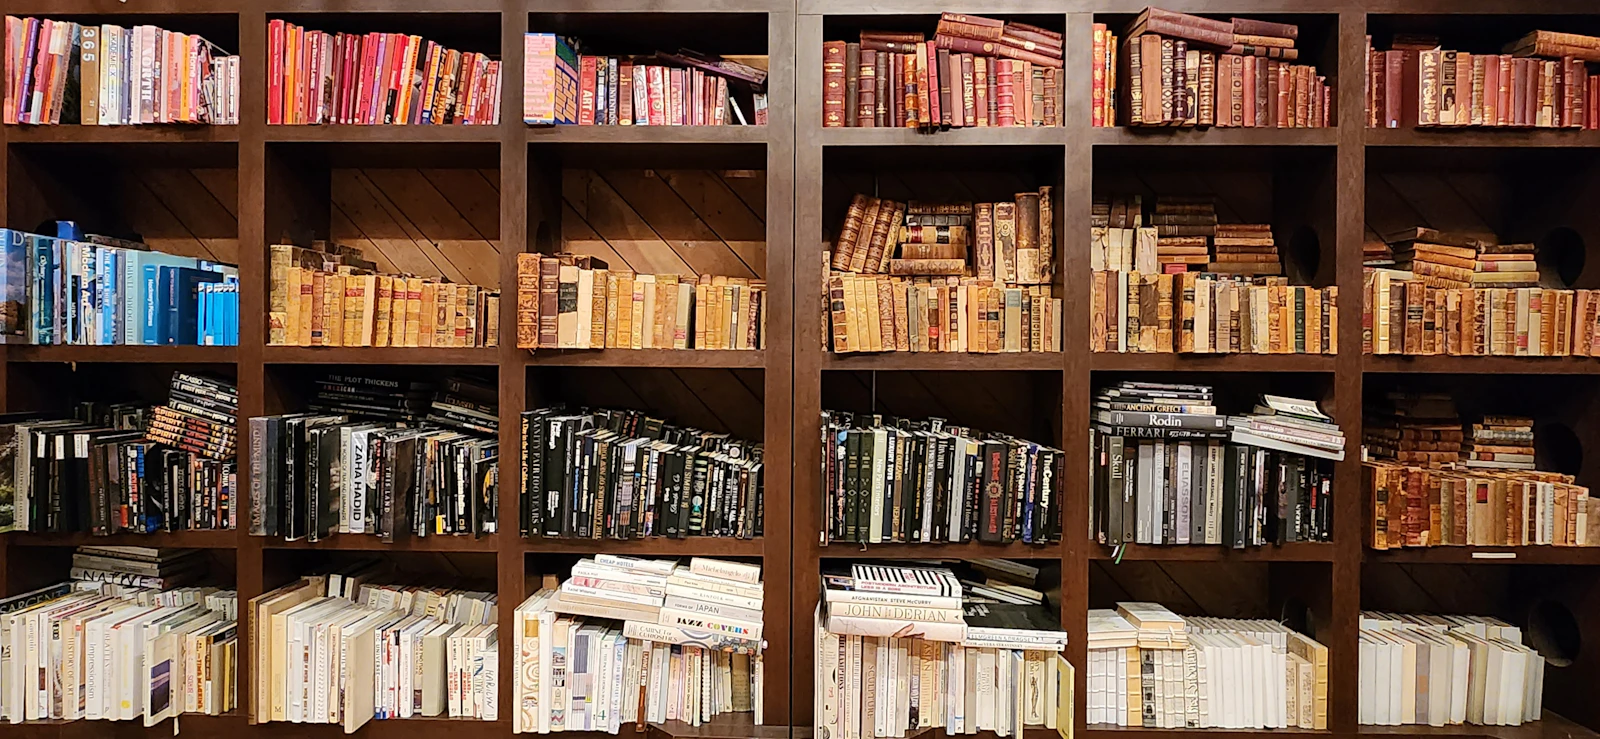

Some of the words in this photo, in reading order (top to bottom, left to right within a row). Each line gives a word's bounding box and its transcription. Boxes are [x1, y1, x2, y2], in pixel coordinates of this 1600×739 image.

[963, 72, 974, 110] WHISTLE
[81, 247, 91, 288] Modern
[80, 289, 91, 306] Art
[146, 278, 154, 306] Hockney's
[179, 373, 203, 385] PICASSO
[344, 375, 362, 384] PLOT
[364, 377, 399, 387] THICKENS
[154, 407, 181, 419] SPIRIT
[1126, 403, 1155, 412] ANCIENT
[1157, 405, 1181, 413] GREECE
[153, 420, 180, 432] SPIRIT
[155, 414, 182, 426] SPIRIT
[1149, 414, 1181, 426] Rodin
[146, 433, 173, 446] SPIRIT
[150, 427, 177, 439] SPIRIT
[533, 416, 541, 450] VANITY
[1116, 426, 1165, 438] FERRARI
[252, 430, 261, 459] MIND
[887, 436, 895, 462] LUXURY
[354, 444, 363, 479] ZAHA
[533, 451, 541, 473] FAIR
[937, 440, 948, 469] Havana
[887, 463, 895, 480] TOYS
[1112, 454, 1122, 479] Skull
[253, 478, 261, 489] OF
[532, 475, 541, 492] 100
[683, 471, 691, 500] SIMBEL
[1181, 462, 1189, 523] ELIASSON
[253, 491, 261, 526] IMAGES
[353, 481, 362, 521] HADID
[532, 494, 540, 524] YEARS
[874, 490, 882, 516] Interiors
[892, 506, 900, 526] KEMP
[702, 565, 742, 577] Michelangelo
[695, 603, 720, 614] JAPAN
[844, 604, 882, 617] JOHN
[893, 607, 947, 622] DERIAN
[28, 619, 37, 651] Gauguin
[677, 618, 703, 627] JAZZ
[706, 622, 749, 635] COVERS
[375, 633, 381, 643] DC
[923, 644, 932, 671] ASIAN
[67, 671, 74, 680] OF
[87, 643, 96, 699] Impressionism
[867, 665, 875, 719] SCULPTURE
[598, 709, 607, 721] 4
